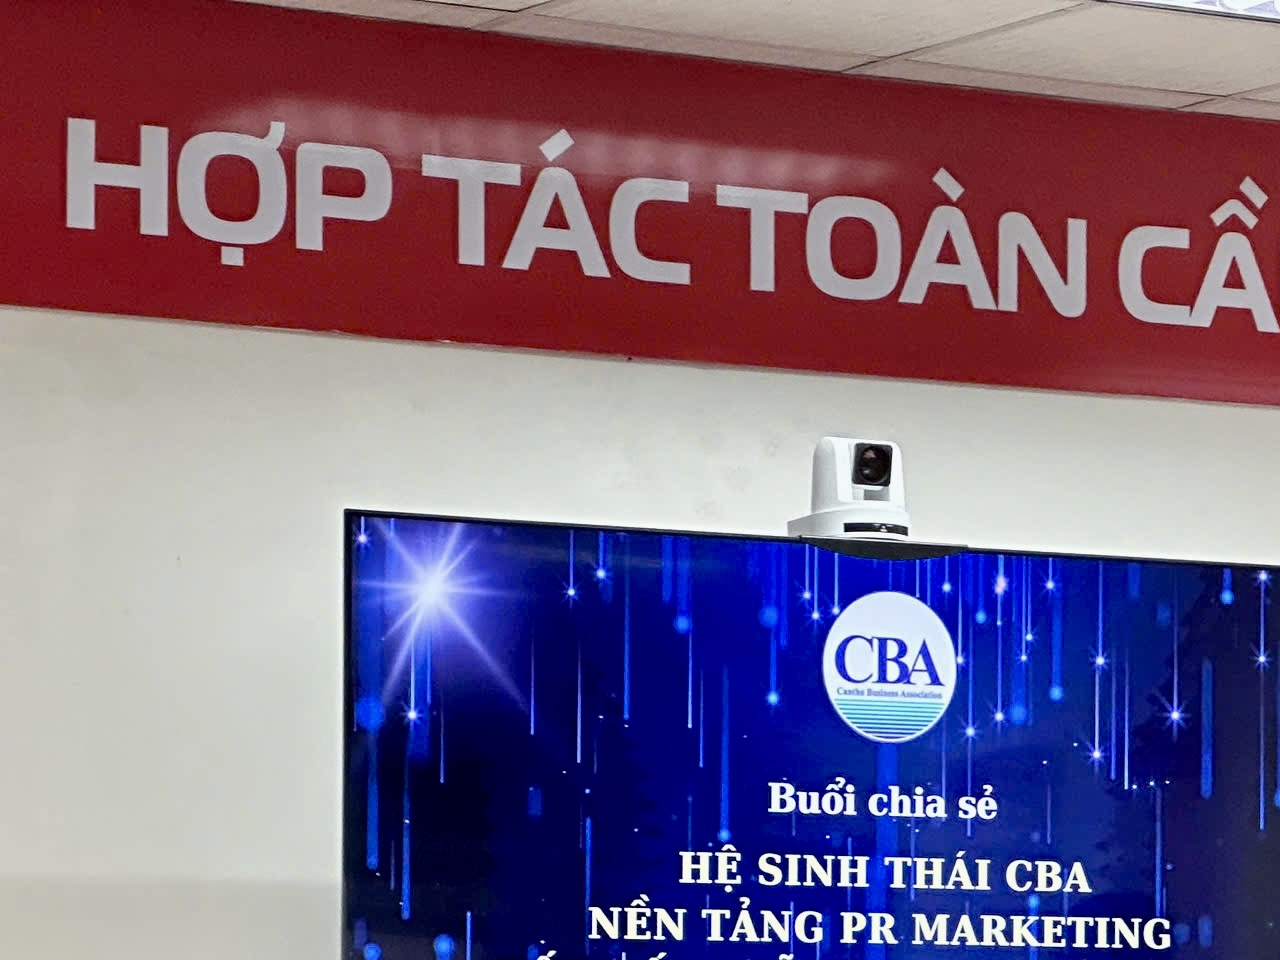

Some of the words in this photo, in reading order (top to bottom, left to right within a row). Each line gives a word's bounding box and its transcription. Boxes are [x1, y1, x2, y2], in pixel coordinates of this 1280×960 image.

[66, 117, 393, 266] HỢP
[421, 128, 690, 286] TÁC
[716, 166, 1087, 319] TOÀN
[834, 634, 946, 687] CBA
[768, 777, 857, 816] Buổi
[868, 785, 947, 818] chia
[958, 785, 998, 820] sẻ
[679, 844, 742, 893] HỆ
[758, 852, 870, 888] SINH
[884, 850, 991, 891] THÁI
[1006, 858, 1092, 893] CBA
[588, 894, 687, 941] NỀN
[702, 897, 824, 943] TẢNG
[840, 911, 899, 945] PR
[912, 912, 1172, 950] MARKETING
